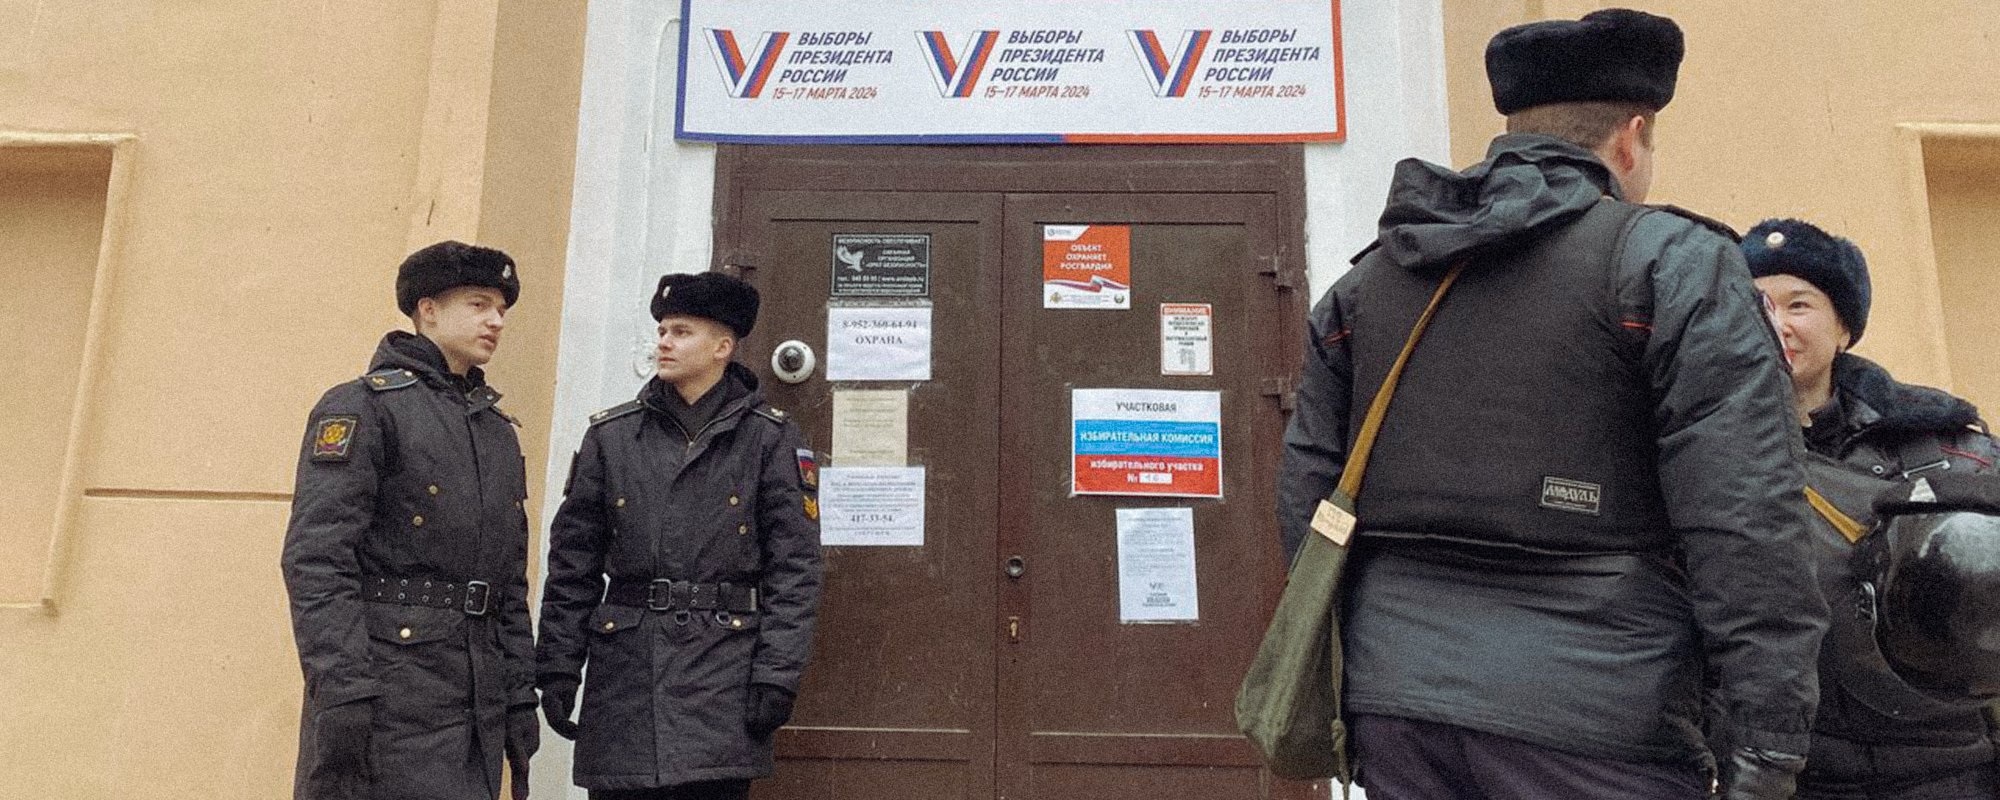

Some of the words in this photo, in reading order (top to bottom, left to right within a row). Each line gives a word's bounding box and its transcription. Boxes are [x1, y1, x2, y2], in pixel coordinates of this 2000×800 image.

[797, 32, 873, 45] ВЫБОРЫ
[1008, 30, 1083, 44] ВЫБОРЫ
[1220, 29, 1297, 43] ВЫБОРЫ
[788, 50, 894, 66] ПРЕЗИДЕНТА
[999, 49, 1105, 64] ПРЕЗИДЕНТА
[1212, 47, 1320, 64] ПРЕЗИДЕНТА
[779, 69, 848, 83] РОССИИ
[990, 68, 1059, 81] РОССИИ
[1204, 68, 1274, 81] РОССИИ
[806, 87, 847, 99] МАРТА
[848, 87, 878, 99] 2024
[1017, 86, 1059, 98] МАРТА
[1060, 86, 1090, 98] 2024
[1232, 85, 1275, 97] МАРТА
[1276, 84, 1307, 97] 2024
[1071, 244, 1102, 252] ОБЪЕКТ
[1065, 253, 1108, 261] ОХРАНЯЕТ
[855, 335, 903, 345] ОХРАНА
[1116, 402, 1177, 412] УЧАСТКОВАЯ
[1080, 431, 1161, 443] ИЗБИРАТЕЛЬНАЯ
[1161, 433, 1214, 444] КОМИССИЯ
[1089, 459, 1166, 471] избирательного
[1166, 462, 1204, 473] участка
